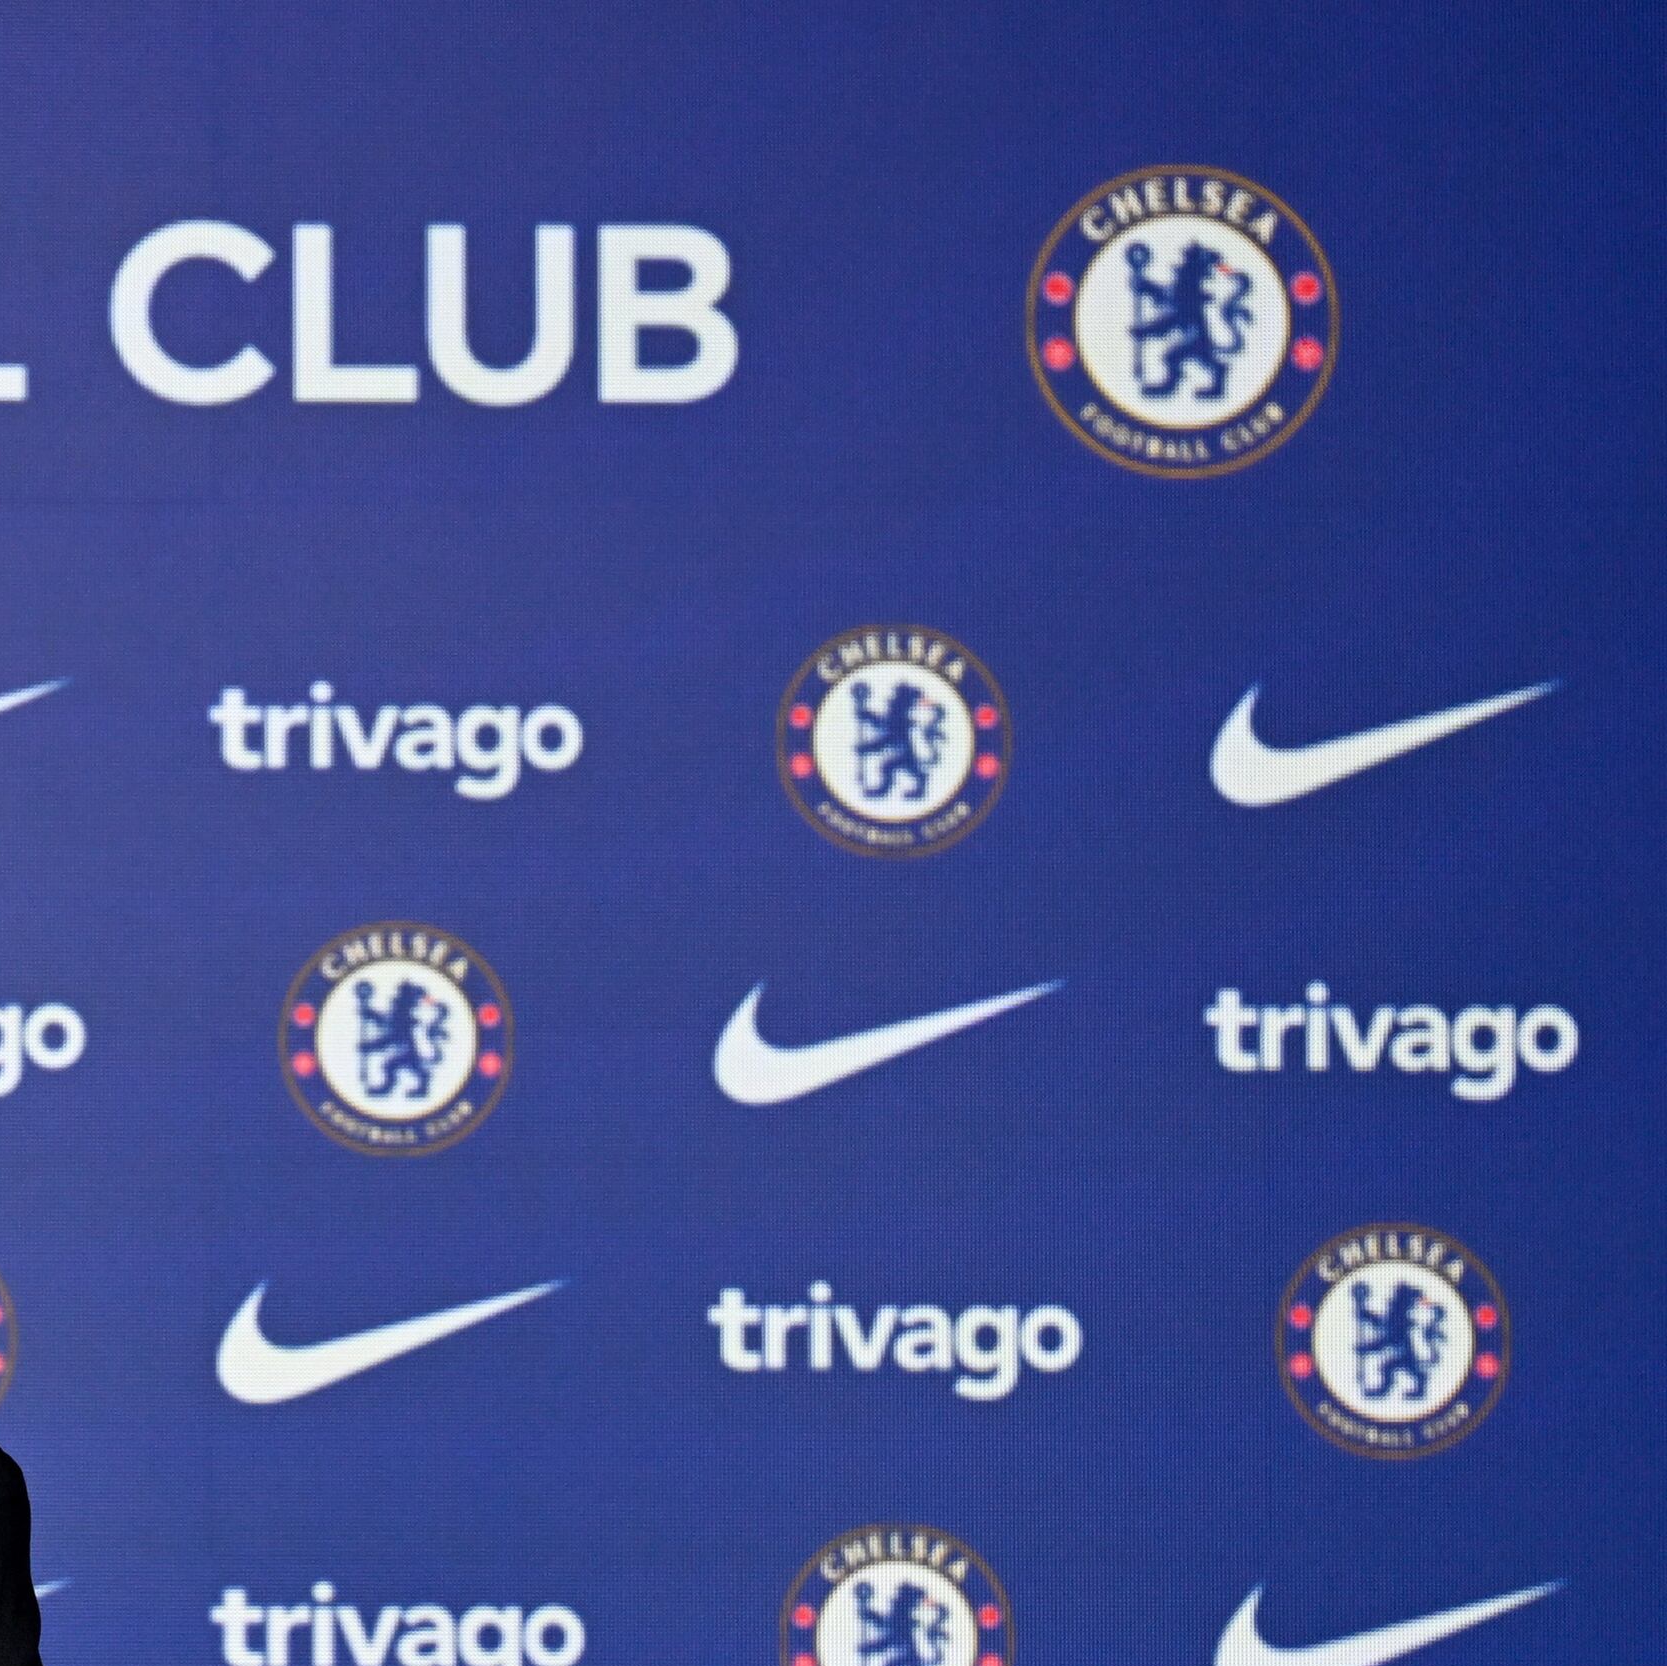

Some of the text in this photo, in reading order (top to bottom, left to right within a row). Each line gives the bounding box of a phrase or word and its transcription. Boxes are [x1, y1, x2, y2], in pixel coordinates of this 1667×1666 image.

[1080, 178, 1278, 245] CHELSEA
[112, 222, 736, 405] CLUB
[1079, 402, 1285, 459] FOOTBALL CLUB
[817, 633, 966, 683] CHELSEA
[210, 682, 582, 799] trivago
[319, 930, 469, 981] CHELSEA
[1207, 985, 1577, 1099] trivago
[1317, 1233, 1465, 1283] CHELSEA
[709, 1283, 1081, 1400] trivago
[820, 1532, 969, 1583] CHELSEA
